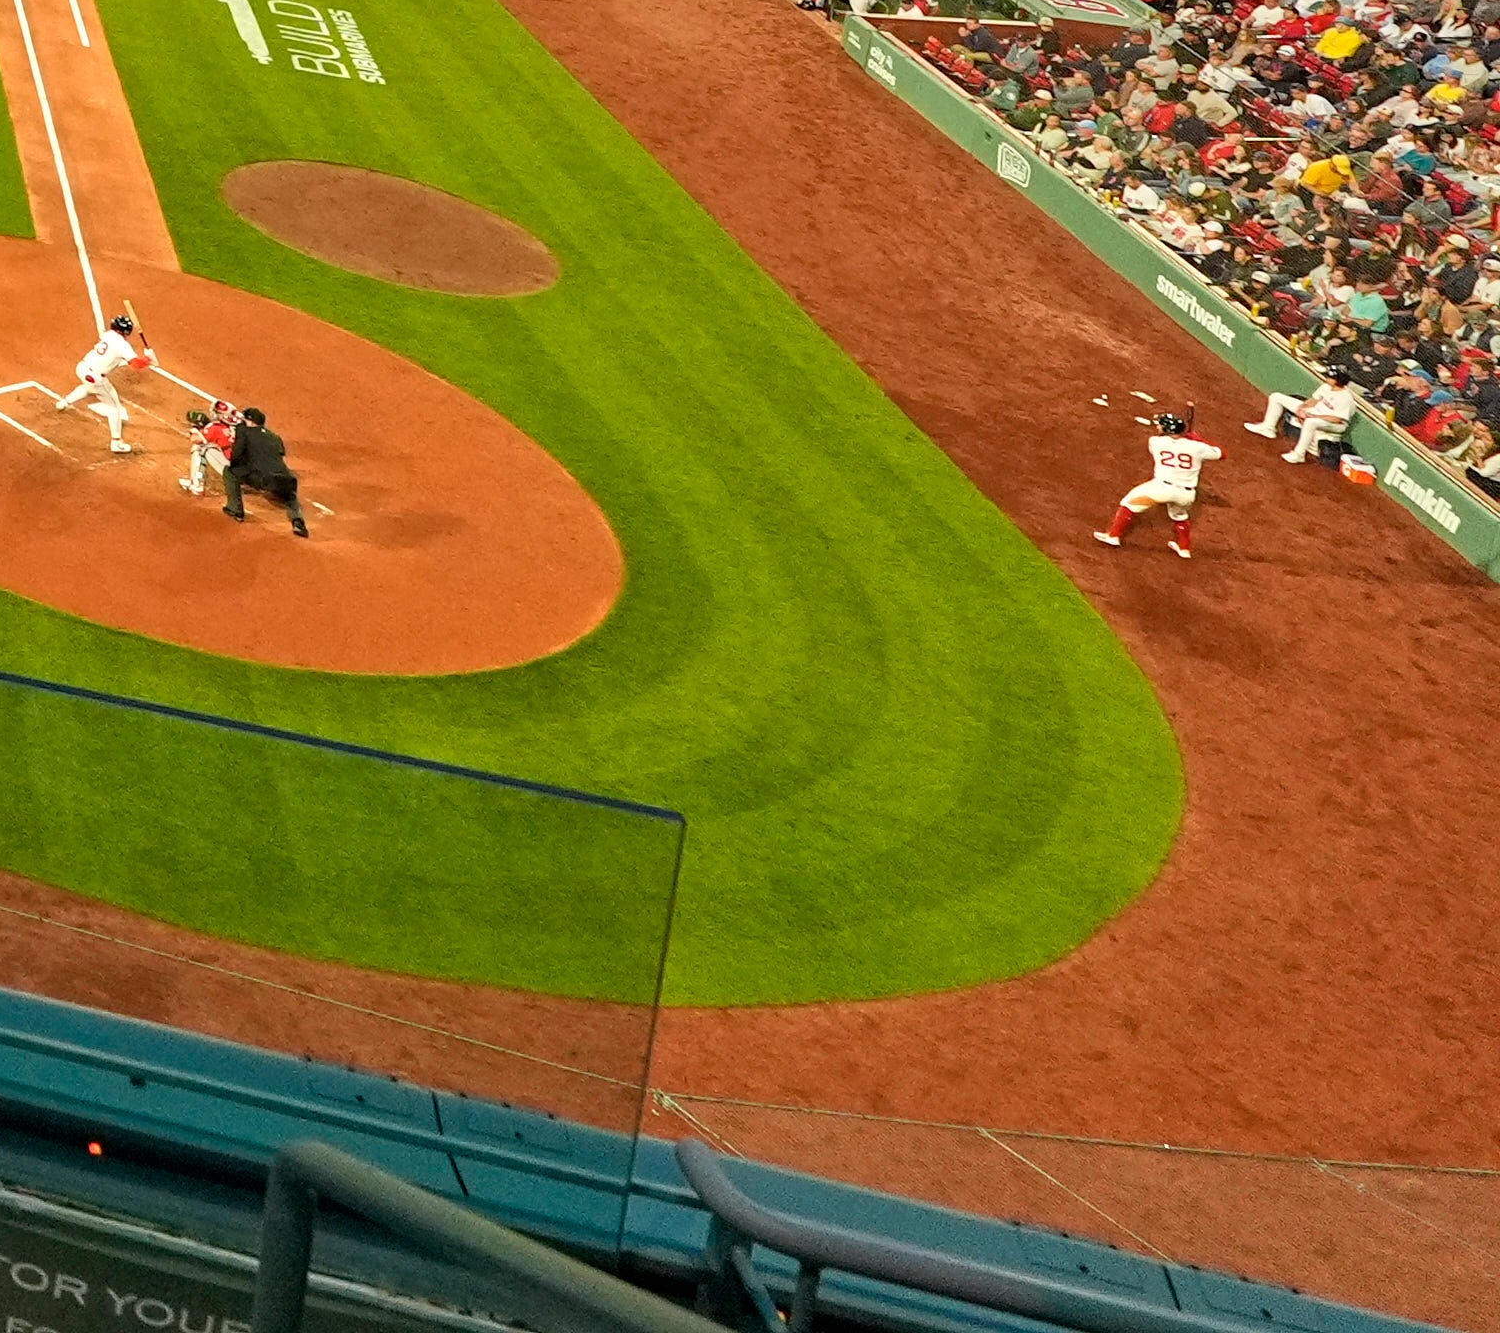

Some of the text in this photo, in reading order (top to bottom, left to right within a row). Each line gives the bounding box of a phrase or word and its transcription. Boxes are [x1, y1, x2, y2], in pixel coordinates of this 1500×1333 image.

[327, 7, 387, 86] SUBMARINES
[1156, 273, 1237, 349] smartwater
[1158, 449, 1194, 471] 29
